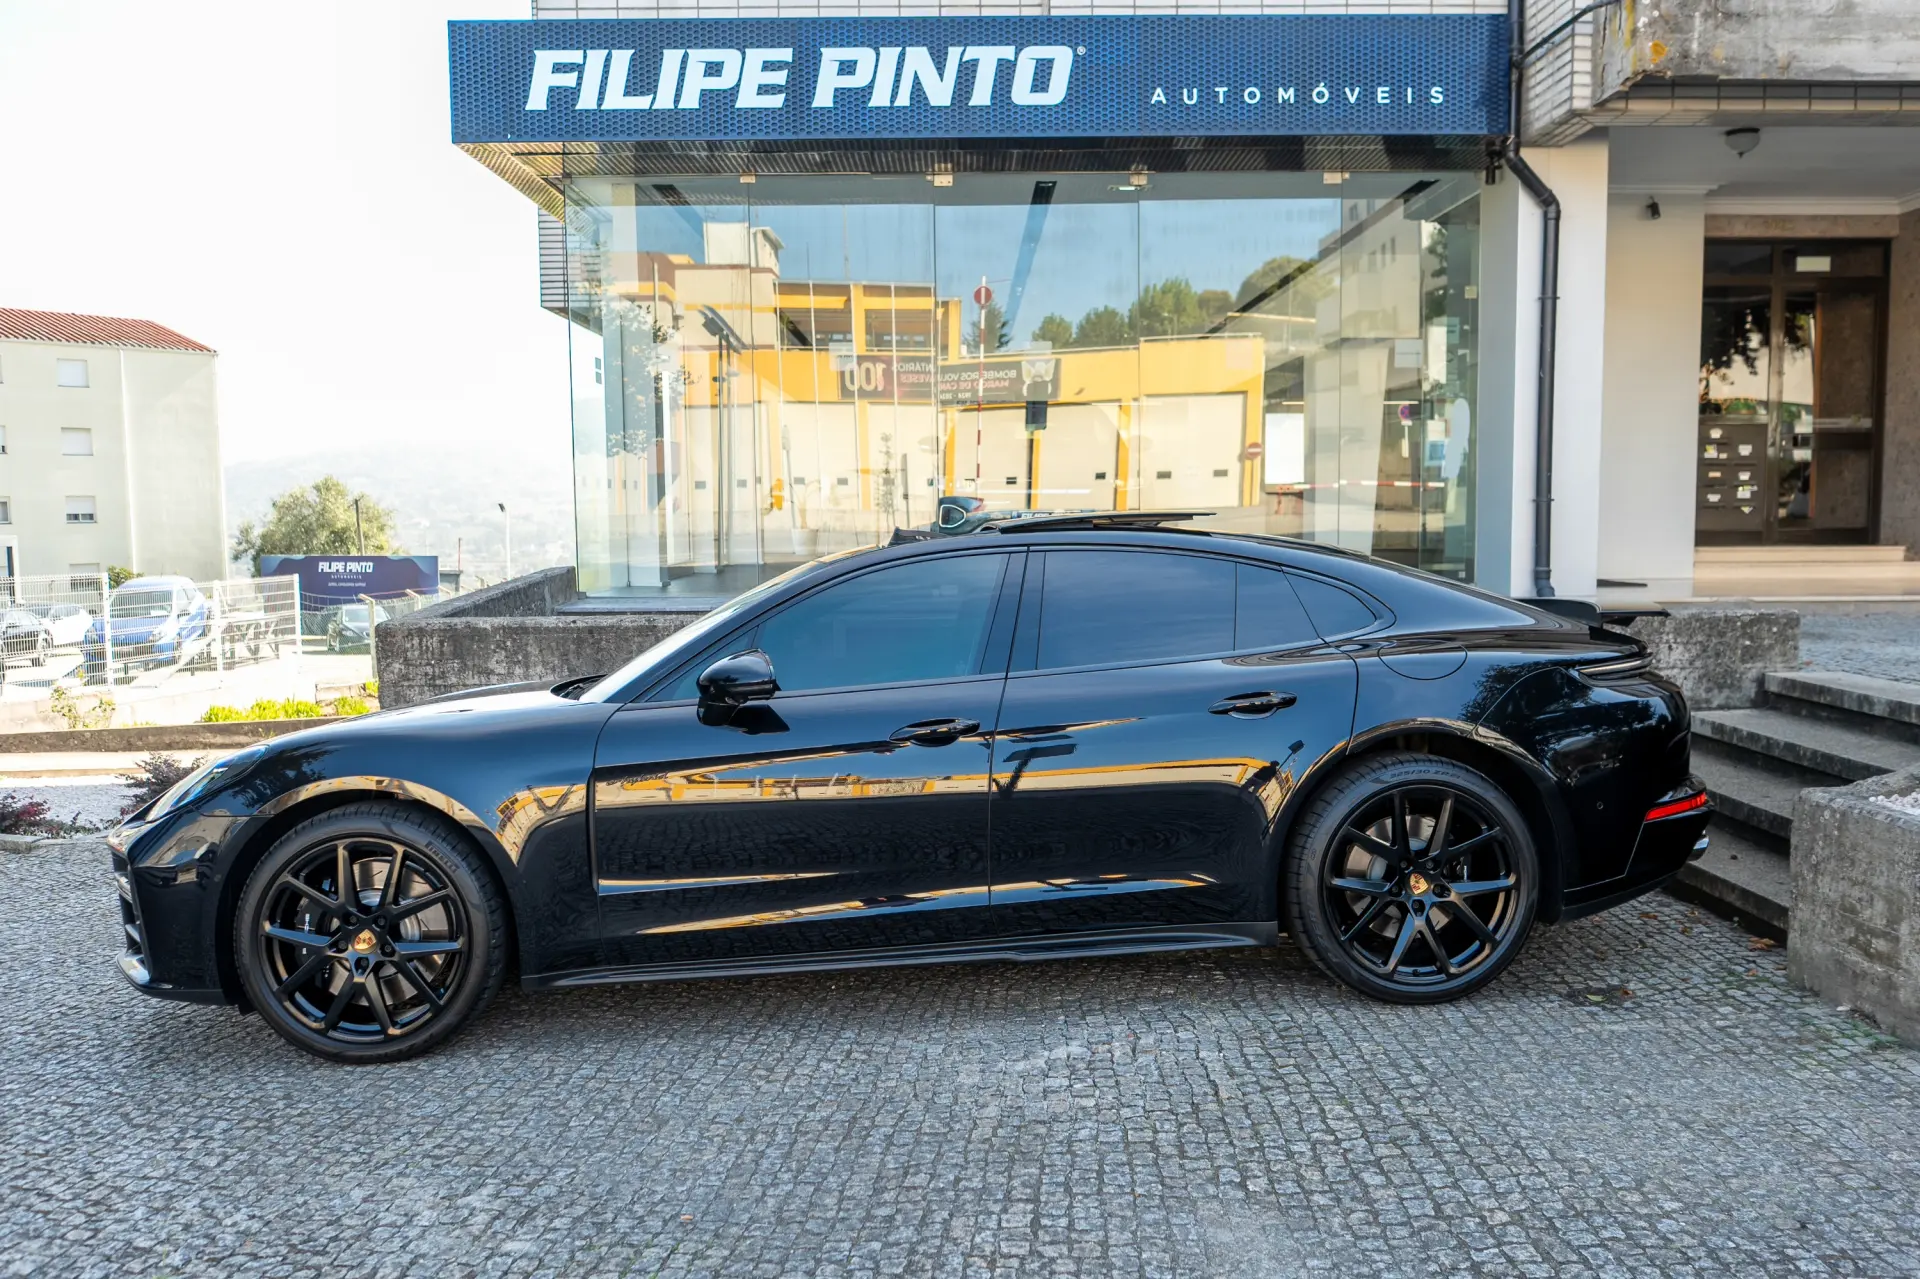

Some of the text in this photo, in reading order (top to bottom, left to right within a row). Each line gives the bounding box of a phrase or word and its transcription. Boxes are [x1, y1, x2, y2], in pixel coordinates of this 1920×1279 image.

[524, 45, 1074, 111] FILIPE PINTO
[1150, 82, 1445, 105] AUTOMÓVEIS
[318, 561, 373, 573] FILIPE PINTO
